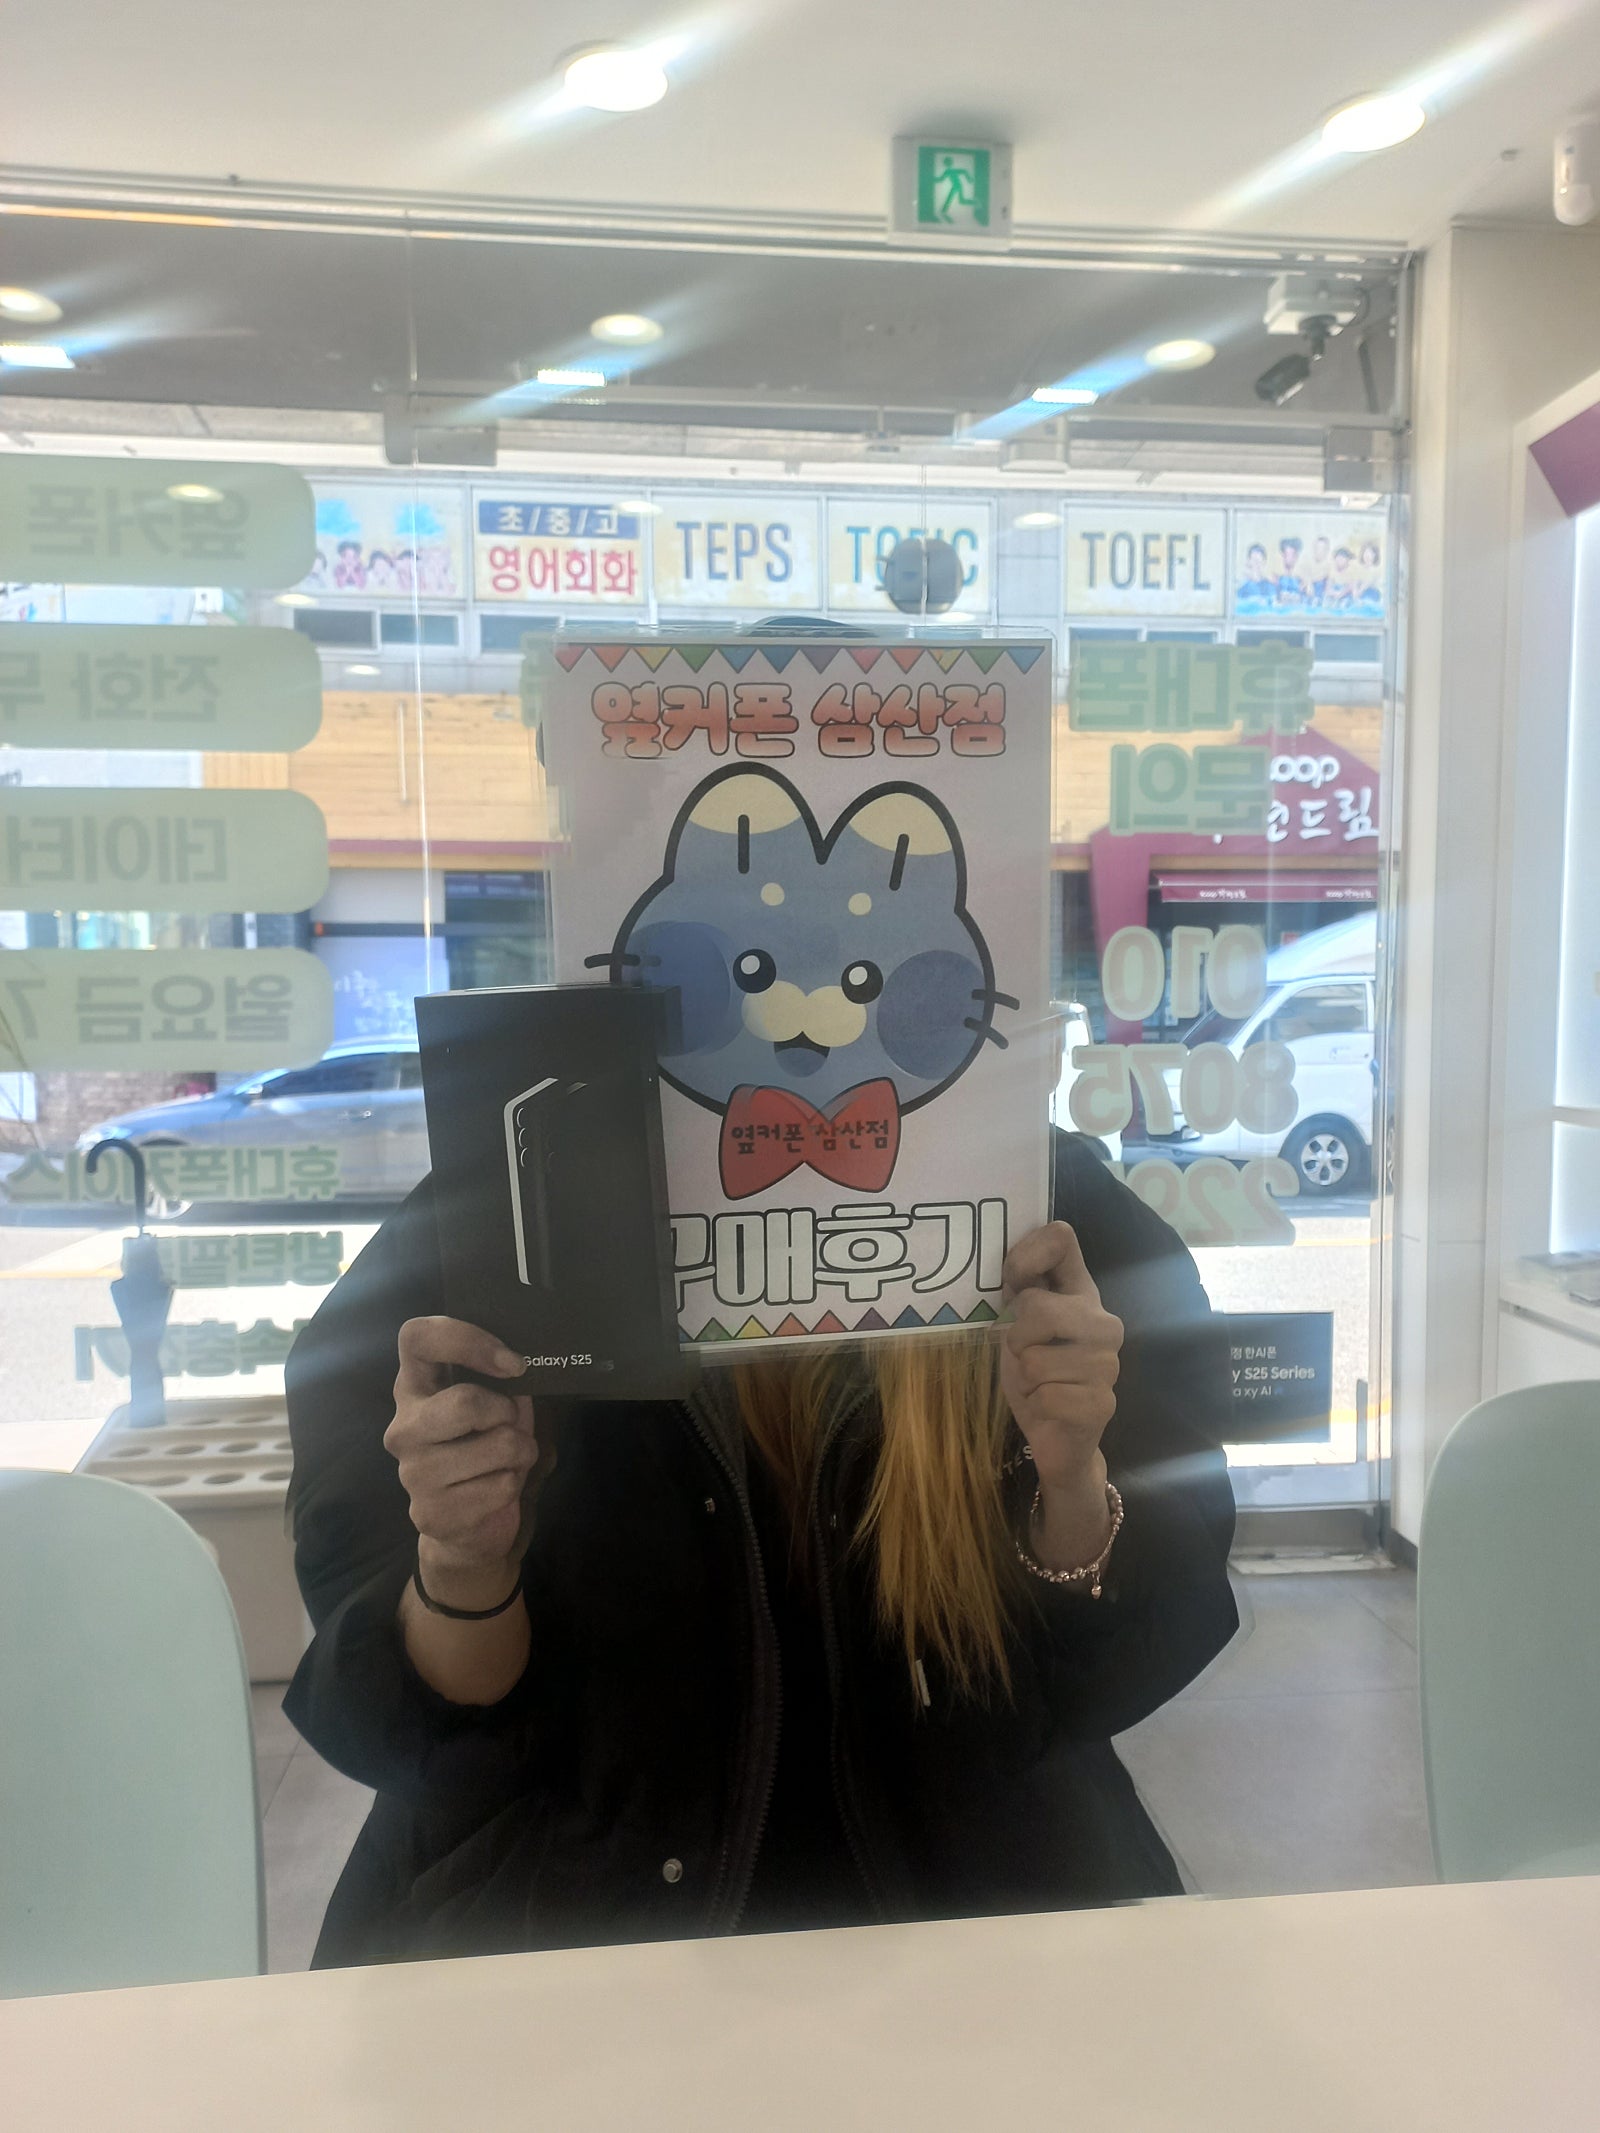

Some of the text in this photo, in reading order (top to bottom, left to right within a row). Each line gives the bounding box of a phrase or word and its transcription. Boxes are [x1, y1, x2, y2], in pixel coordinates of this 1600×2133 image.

[498, 505, 620, 535] 초/중/고
[490, 546, 638, 595] 영어회화
[676, 521, 793, 583] TEPS
[846, 525, 979, 588] TOC
[1080, 531, 1212, 591] TOEFL
[591, 681, 1007, 760] 옆커폰 삼산점
[731, 1120, 890, 1155] 옆커폰 삼산점
[523, 1355, 569, 1369] Galaxy
[570, 1353, 593, 1367] S25
[1244, 1367, 1269, 1380] S25
[1270, 1364, 1315, 1380] Series
